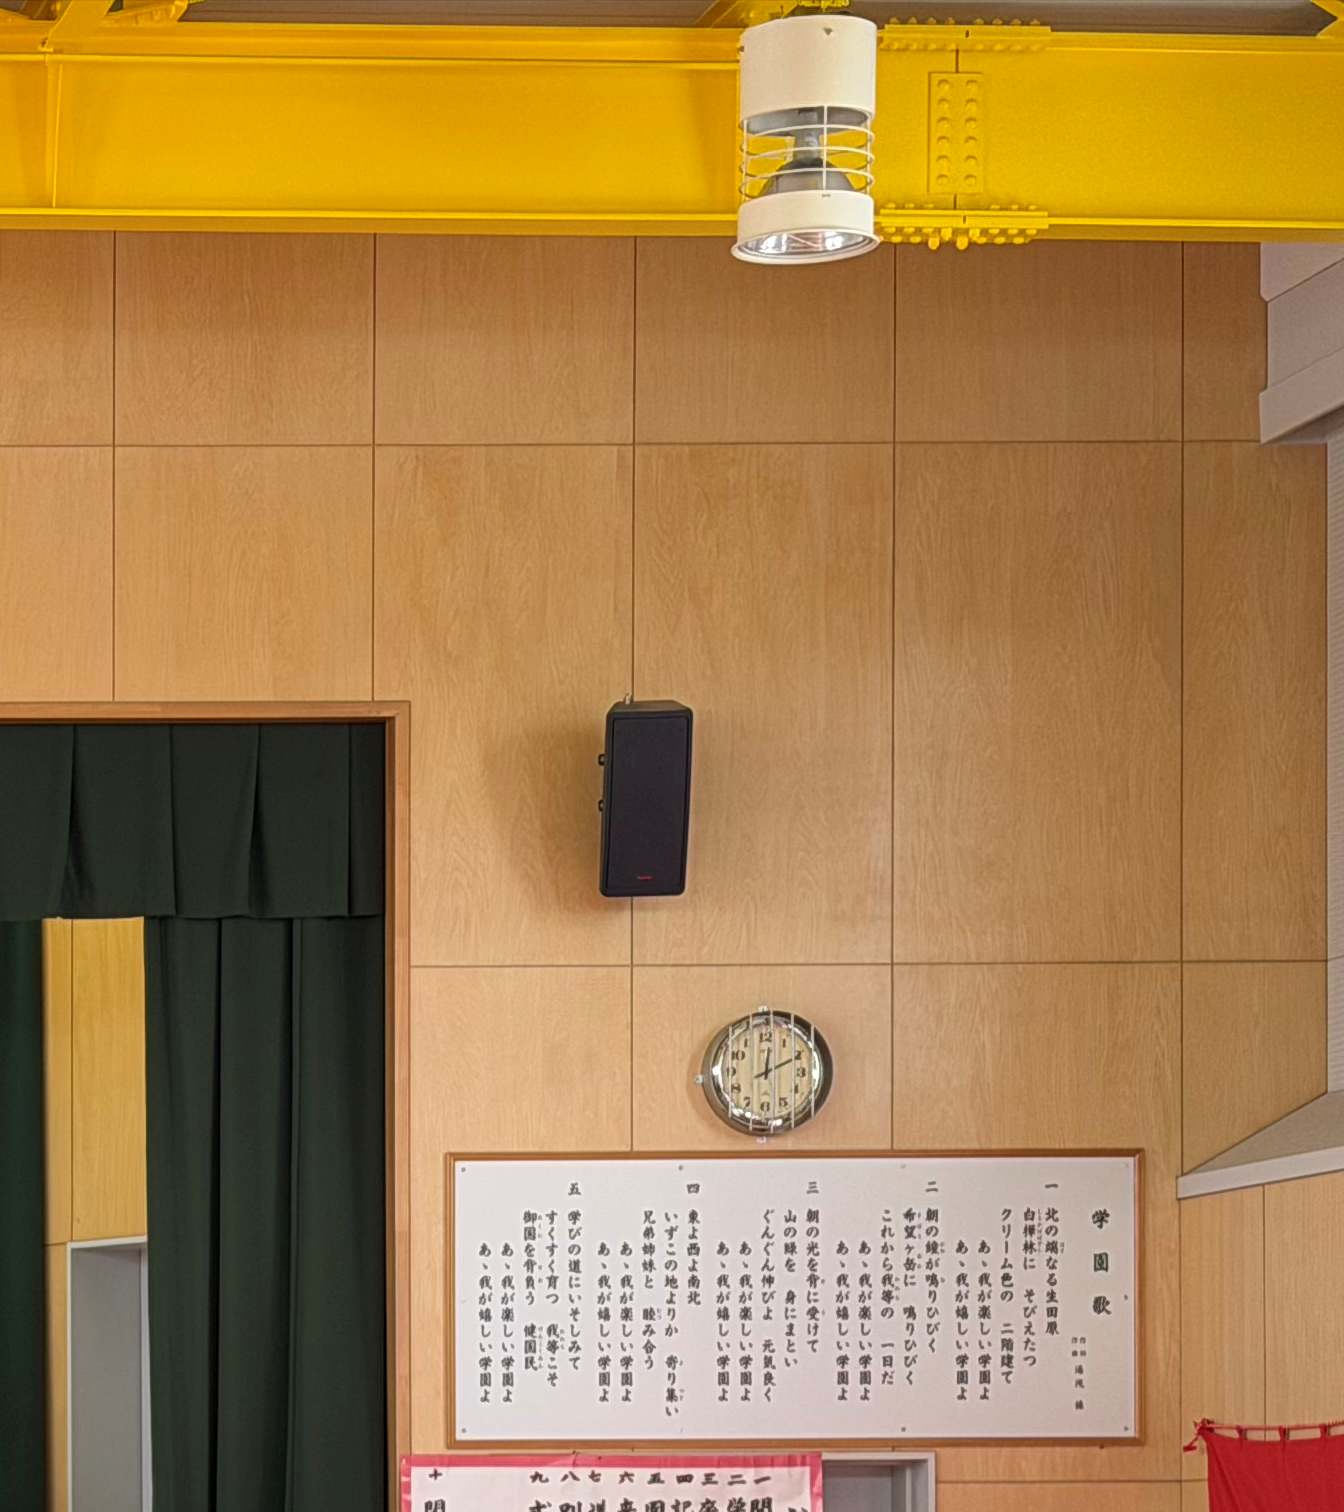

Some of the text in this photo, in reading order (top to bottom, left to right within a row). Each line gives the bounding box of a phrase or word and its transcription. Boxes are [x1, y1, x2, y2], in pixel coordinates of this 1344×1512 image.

[1092, 1209, 1112, 1315] 学園歌
[1023, 1289, 1037, 1366] そびえたつ
